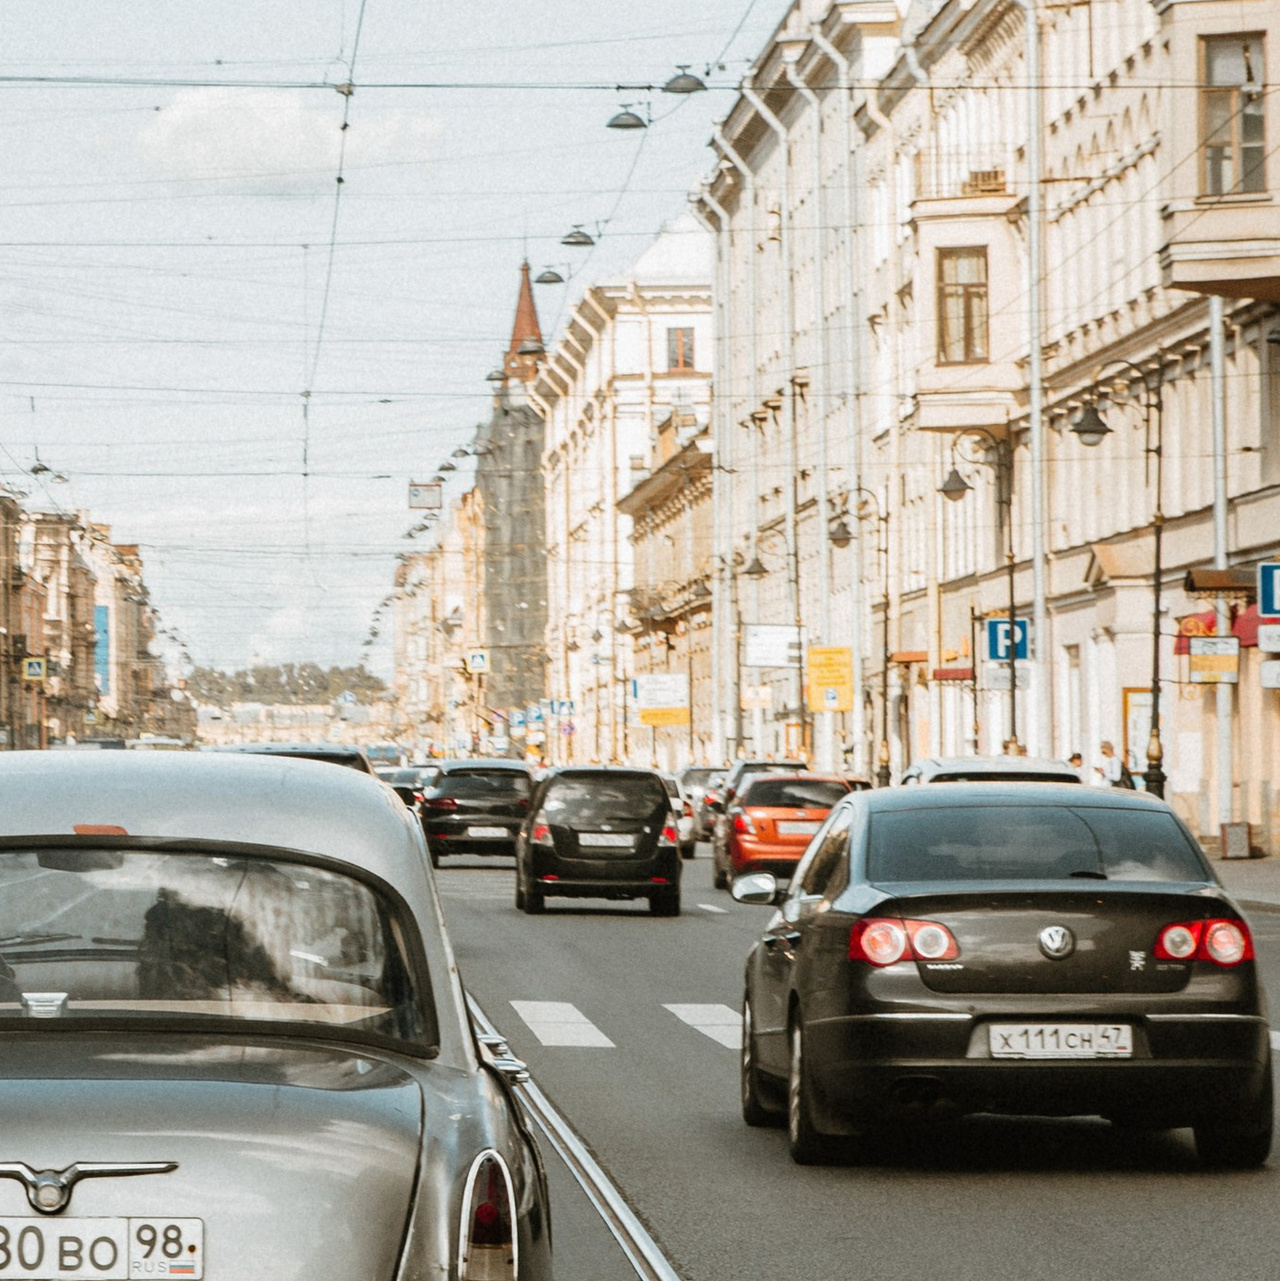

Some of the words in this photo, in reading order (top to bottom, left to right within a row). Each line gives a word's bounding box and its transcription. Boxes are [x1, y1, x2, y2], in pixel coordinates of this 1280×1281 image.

[997, 623, 1023, 658] P
[136, 1224, 183, 1259] 98
[132, 1261, 167, 1273] RUS
